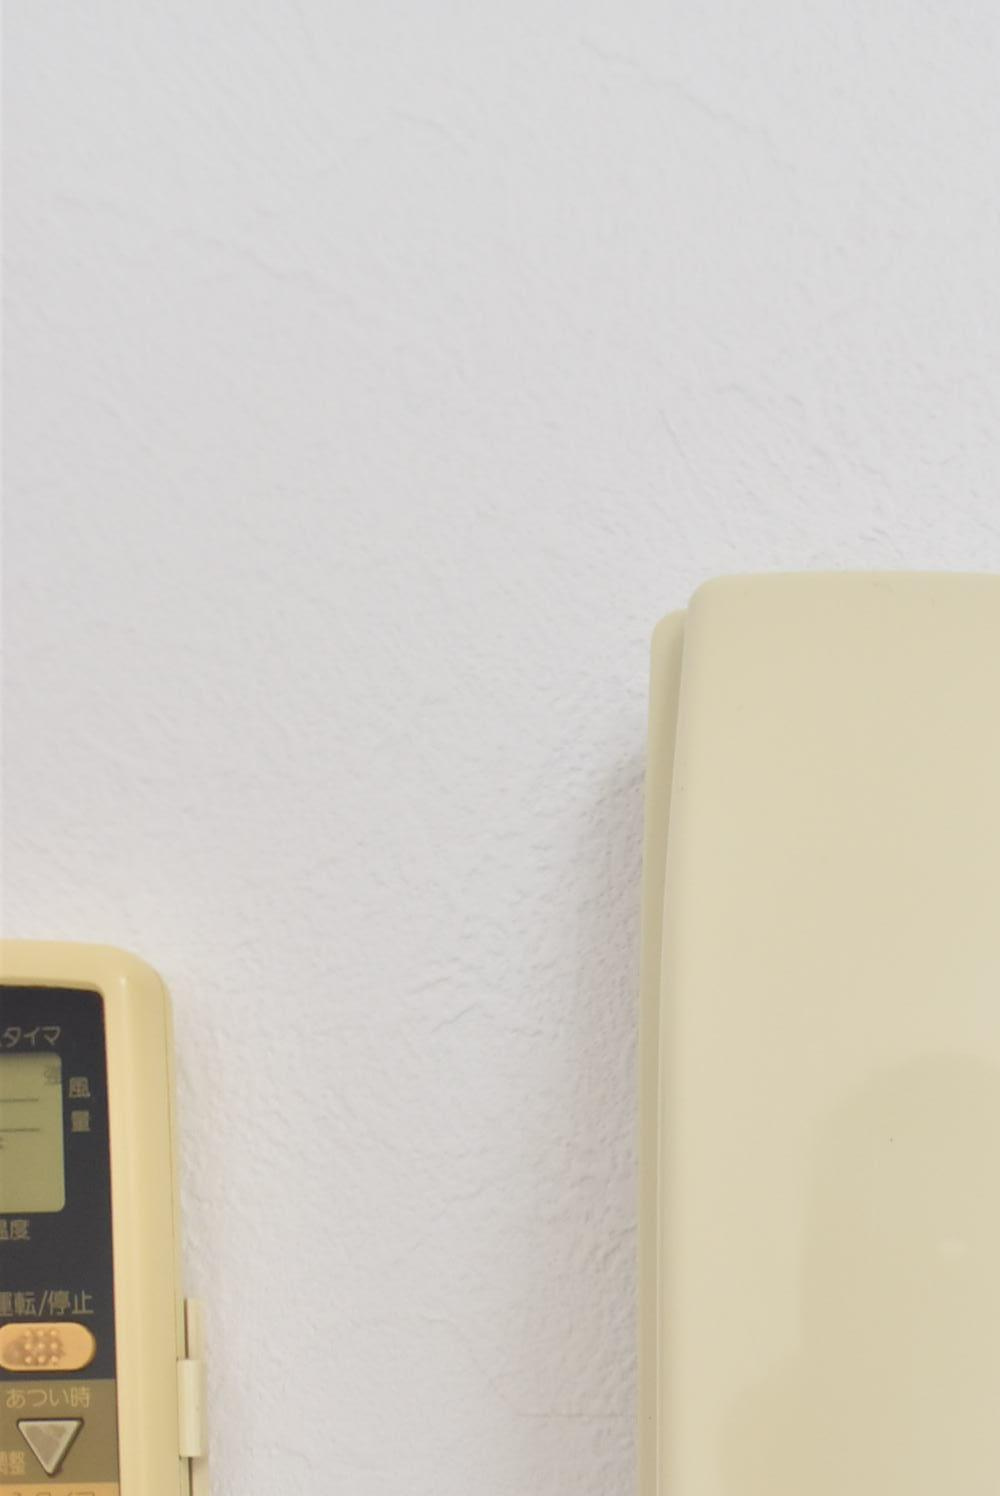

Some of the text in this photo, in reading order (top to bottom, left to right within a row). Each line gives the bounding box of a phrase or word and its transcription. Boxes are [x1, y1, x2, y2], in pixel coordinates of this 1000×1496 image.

[0, 1026, 61, 1047] タイマ
[6, 1387, 90, 1408] あつい時
